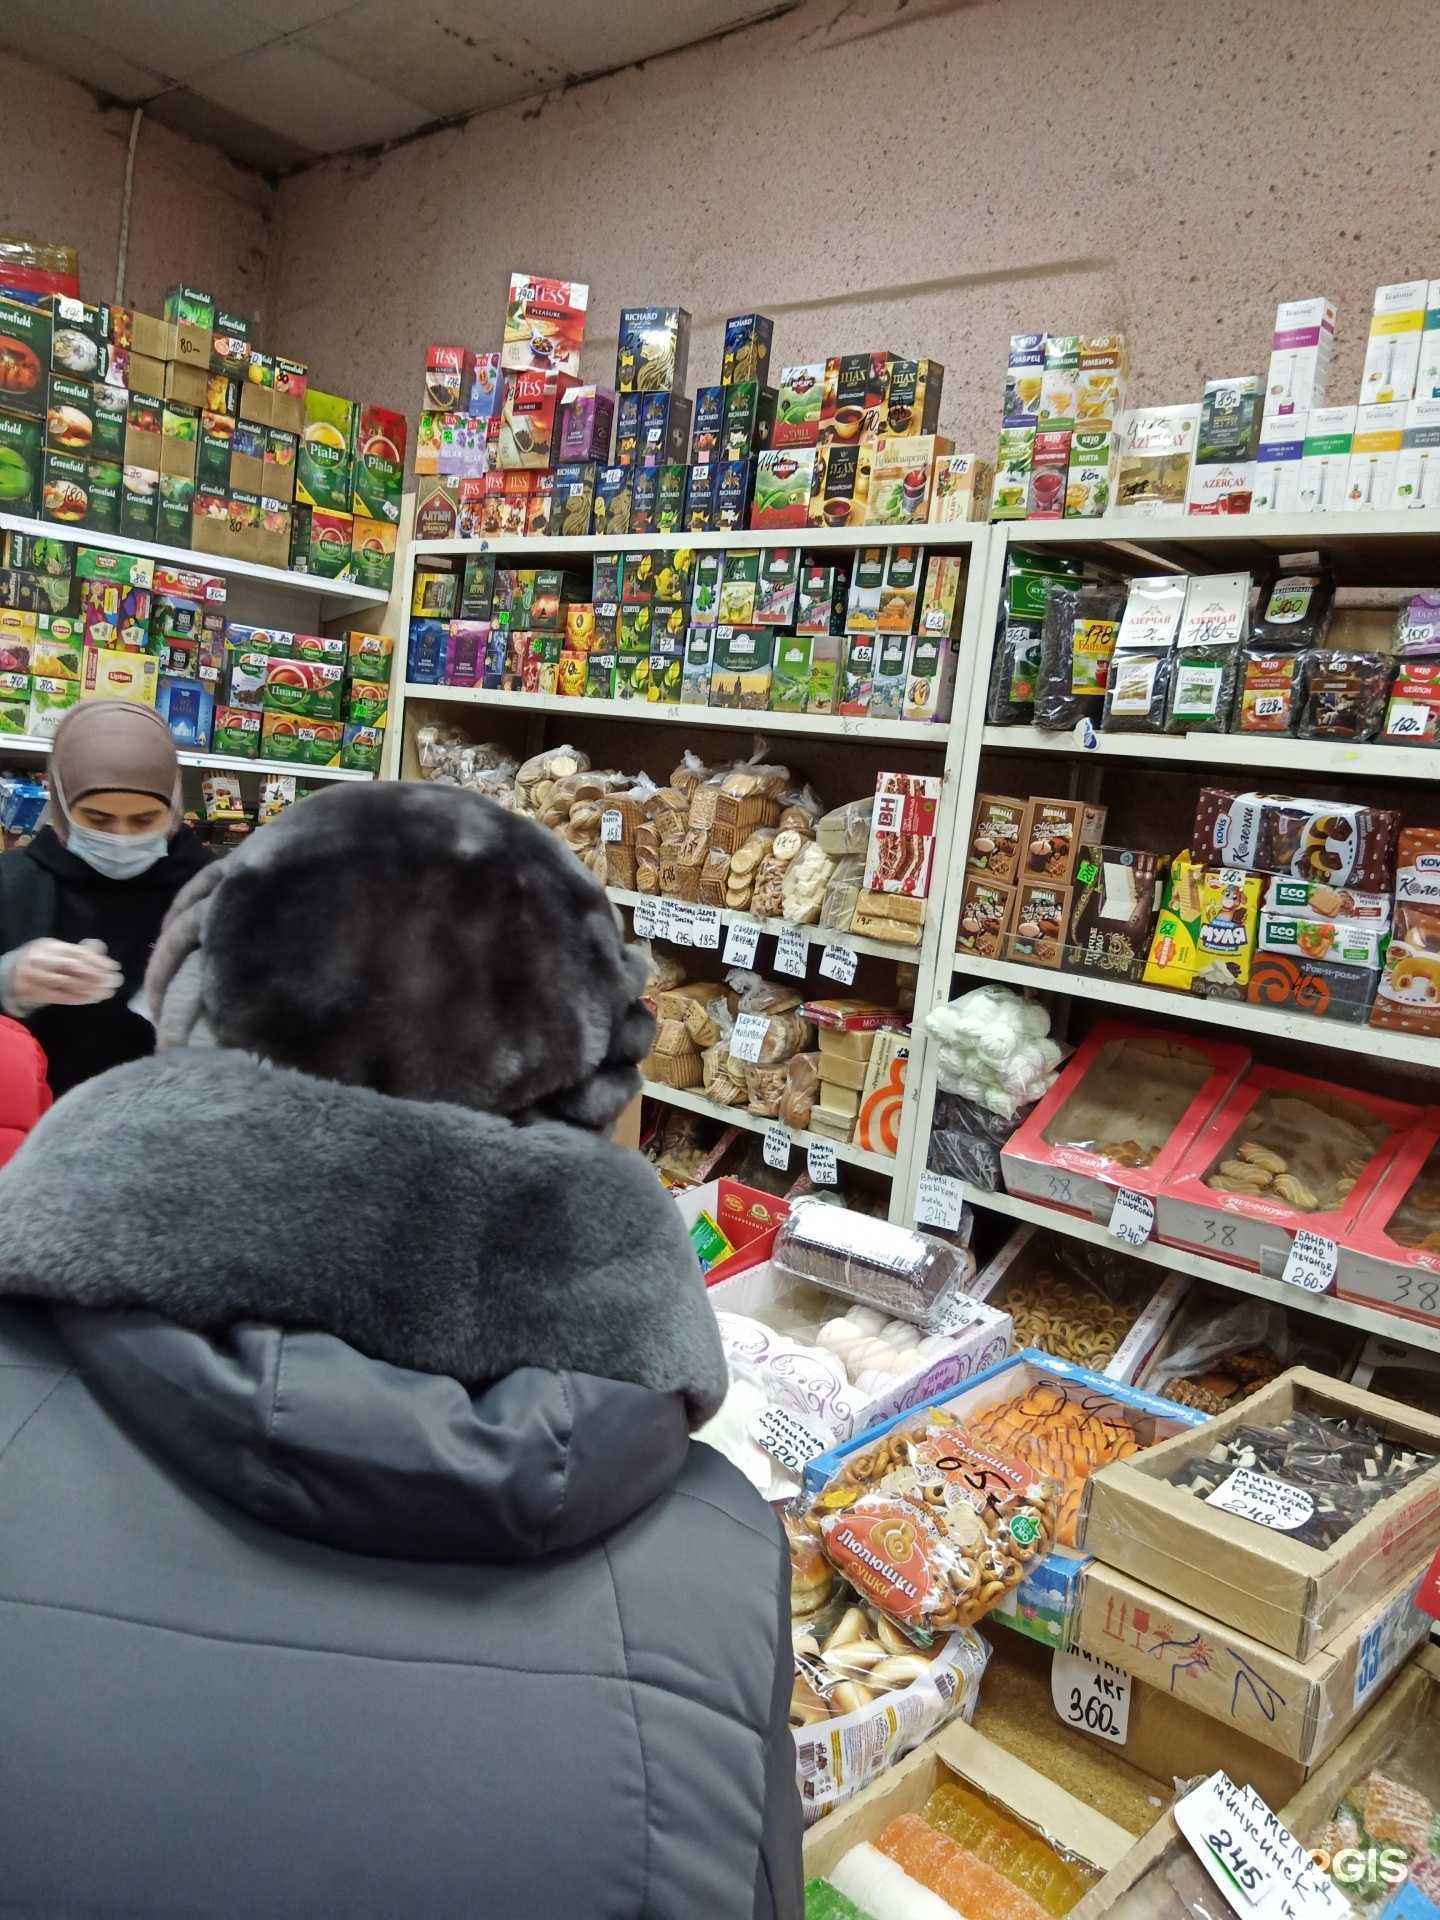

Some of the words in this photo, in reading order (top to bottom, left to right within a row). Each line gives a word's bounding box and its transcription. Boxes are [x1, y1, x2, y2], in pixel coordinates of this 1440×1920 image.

[535, 285, 566, 305] TESS
[531, 309, 561, 318] PLEASURE
[625, 313, 657, 321] RICHARD
[729, 319, 752, 328] RICHARD
[435, 349, 457, 364] TESS
[518, 379, 541, 396] TESS
[310, 443, 339, 461] Piala
[51, 456, 84, 473] Greenfield
[368, 457, 393, 474] Piala
[557, 468, 580, 476] RICHARD
[488, 476, 503, 489] TESS
[511, 476, 528, 487] TESS
[1203, 476, 1247, 489] AZERÇAY
[464, 483, 479, 495] TESS
[1130, 616, 1170, 624] АЗЕРЧАЙ
[1261, 661, 1278, 669] KEJO
[1329, 663, 1347, 672] KEJO
[109, 672, 132, 683] Lipton
[271, 685, 303, 698] Пиала
[1216, 818, 1227, 844] KOVIS
[1420, 858, 1440, 868] KOV
[1280, 887, 1306, 898] ECO
[1399, 877, 1440, 899] Коле
[1200, 925, 1246, 945] МУЛЯ
[1270, 925, 1296, 937] ECO
[1085, 927, 1098, 965] ПТИЧЬЕ
[1047, 1174, 1072, 1201] 38
[1203, 1220, 1237, 1247] 38
[1298, 1230, 1333, 1251] БАНАН
[1393, 1274, 1439, 1313] 38
[836, 1528, 919, 1599] Люлюшки
